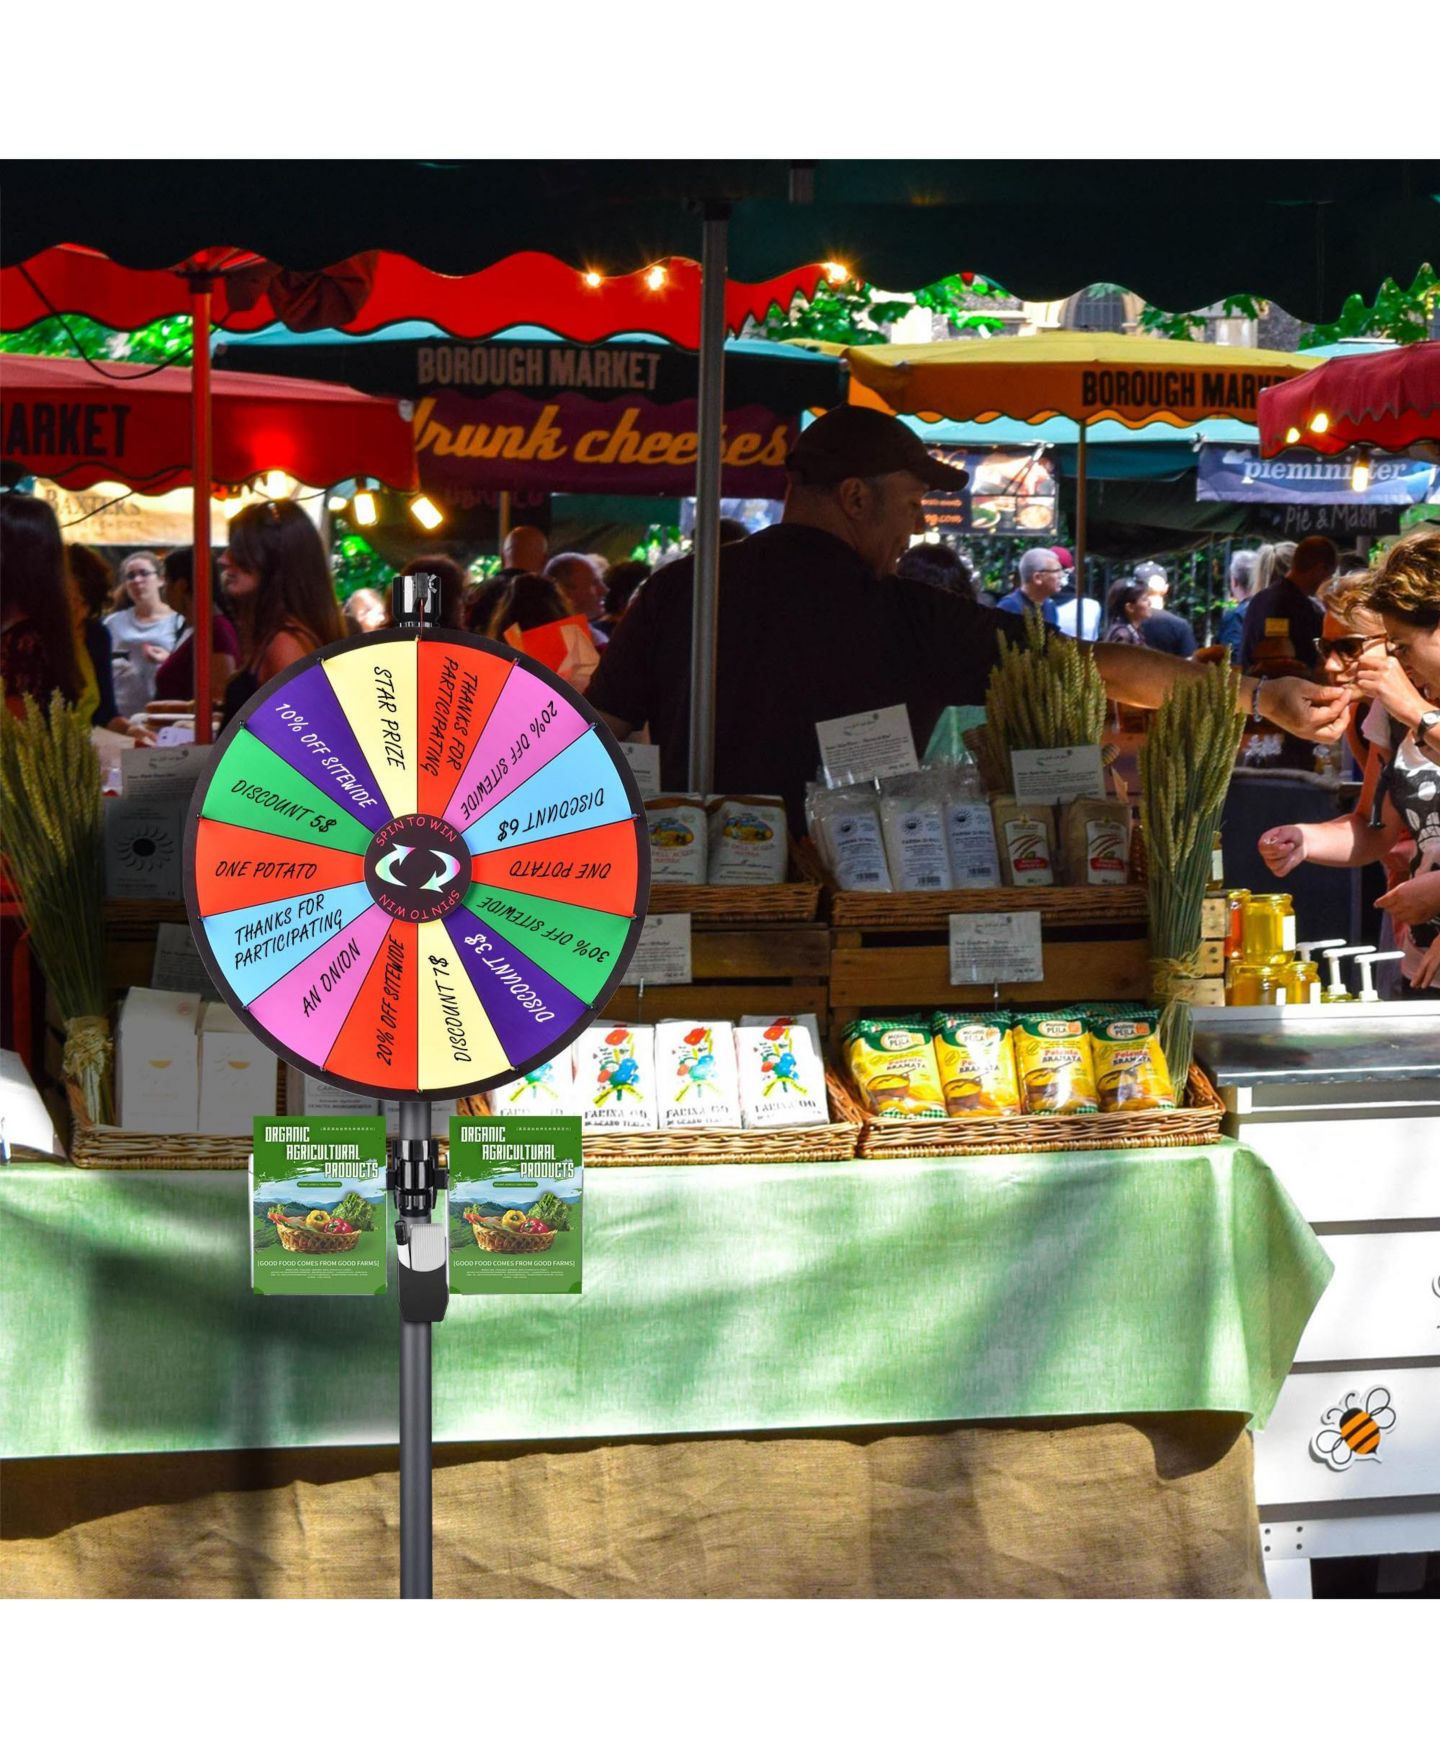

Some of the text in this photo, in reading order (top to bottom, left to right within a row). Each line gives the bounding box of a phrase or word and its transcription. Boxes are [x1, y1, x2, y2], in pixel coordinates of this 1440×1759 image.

[417, 346, 661, 390] BOROUGH MARKET
[1082, 369, 1288, 410] BOROUGH MAR
[0, 402, 131, 457] ARKET
[573, 407, 789, 467] cheees
[1244, 457, 1408, 484] pieminiter
[374, 666, 406, 771] STAR PRIZE
[420, 656, 459, 777] PARTICIPATING
[446, 671, 478, 771] THANKS FOR
[275, 703, 377, 808] 10% OFF SITEWIDE
[460, 700, 558, 821] 20% OFF SITEWIDE
[231, 779, 337, 833] DISCOUNT 5$
[497, 787, 605, 842] DISCOUNT 6$
[376, 816, 457, 847] SPIN TO WIN
[215, 860, 317, 880] ONE POTATO
[509, 860, 612, 880] ONE POTATO
[234, 893, 325, 945] THANKS FOR
[379, 890, 460, 920] SPIN TO WIN
[477, 897, 545, 932] SITEWIDE
[235, 909, 343, 970] PARTICIPATING
[540, 927, 575, 946] OFF
[576, 939, 610, 963] 30%
[302, 938, 361, 1018] AN ONION
[376, 934, 405, 1066] 20% OFF SITEWIDE
[464, 933, 556, 1023] DISCOUNT 3$
[435, 979, 472, 1062] DISCOUNT
[265, 1126, 310, 1142] ORGANIC
[286, 1144, 360, 1160] AGRICULTURAL
[461, 1126, 506, 1142] ORGANIC
[482, 1144, 556, 1160] AGRICULTURAL
[324, 1162, 379, 1178] PRODUCTS
[520, 1162, 575, 1178] PRODUCTS
